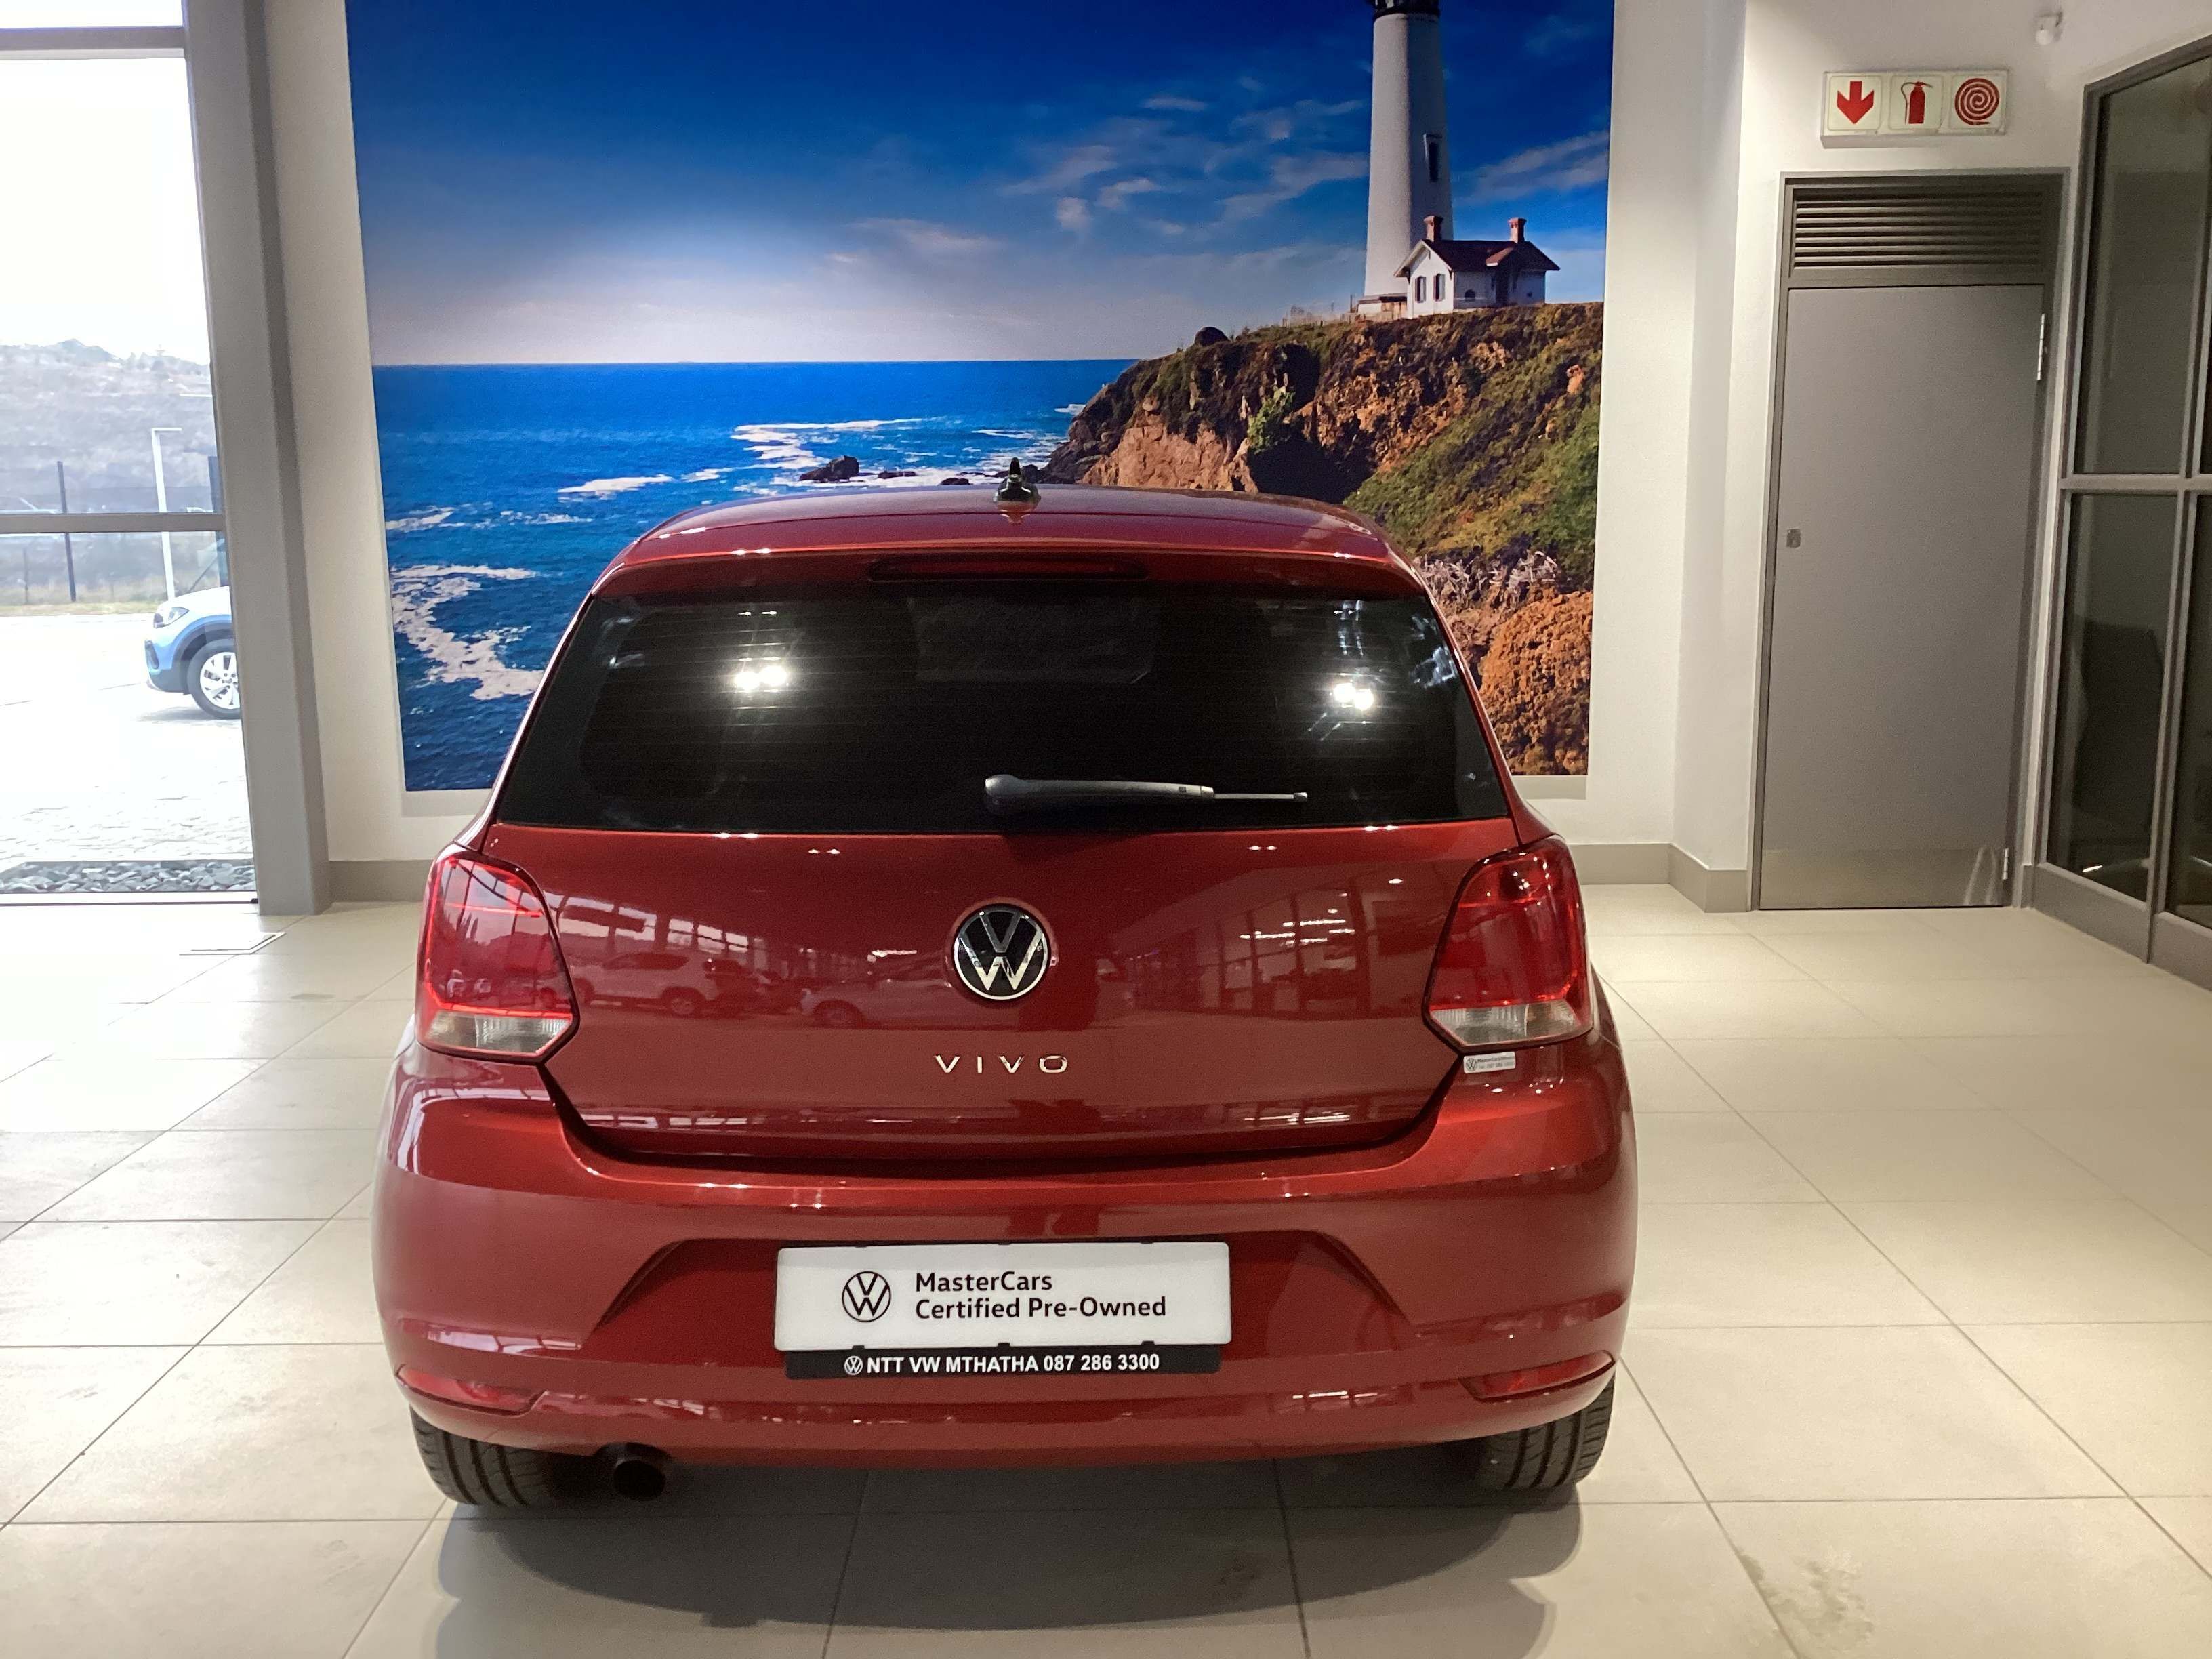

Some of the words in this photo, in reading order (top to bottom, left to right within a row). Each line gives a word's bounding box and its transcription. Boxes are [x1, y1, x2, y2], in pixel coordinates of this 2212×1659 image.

[934, 1054, 1068, 1073] VIVO
[916, 1271, 1052, 1292] MasterCars
[916, 1297, 1020, 1319] Certified
[1029, 1296, 1166, 1317] Pre-Owned
[867, 1357, 905, 1374] NTT
[909, 1356, 941, 1373] VW
[945, 1355, 1039, 1373] MTHATHA
[1043, 1355, 1075, 1372] 087
[1080, 1354, 1112, 1371] 286
[1118, 1353, 1160, 1370] 3300
